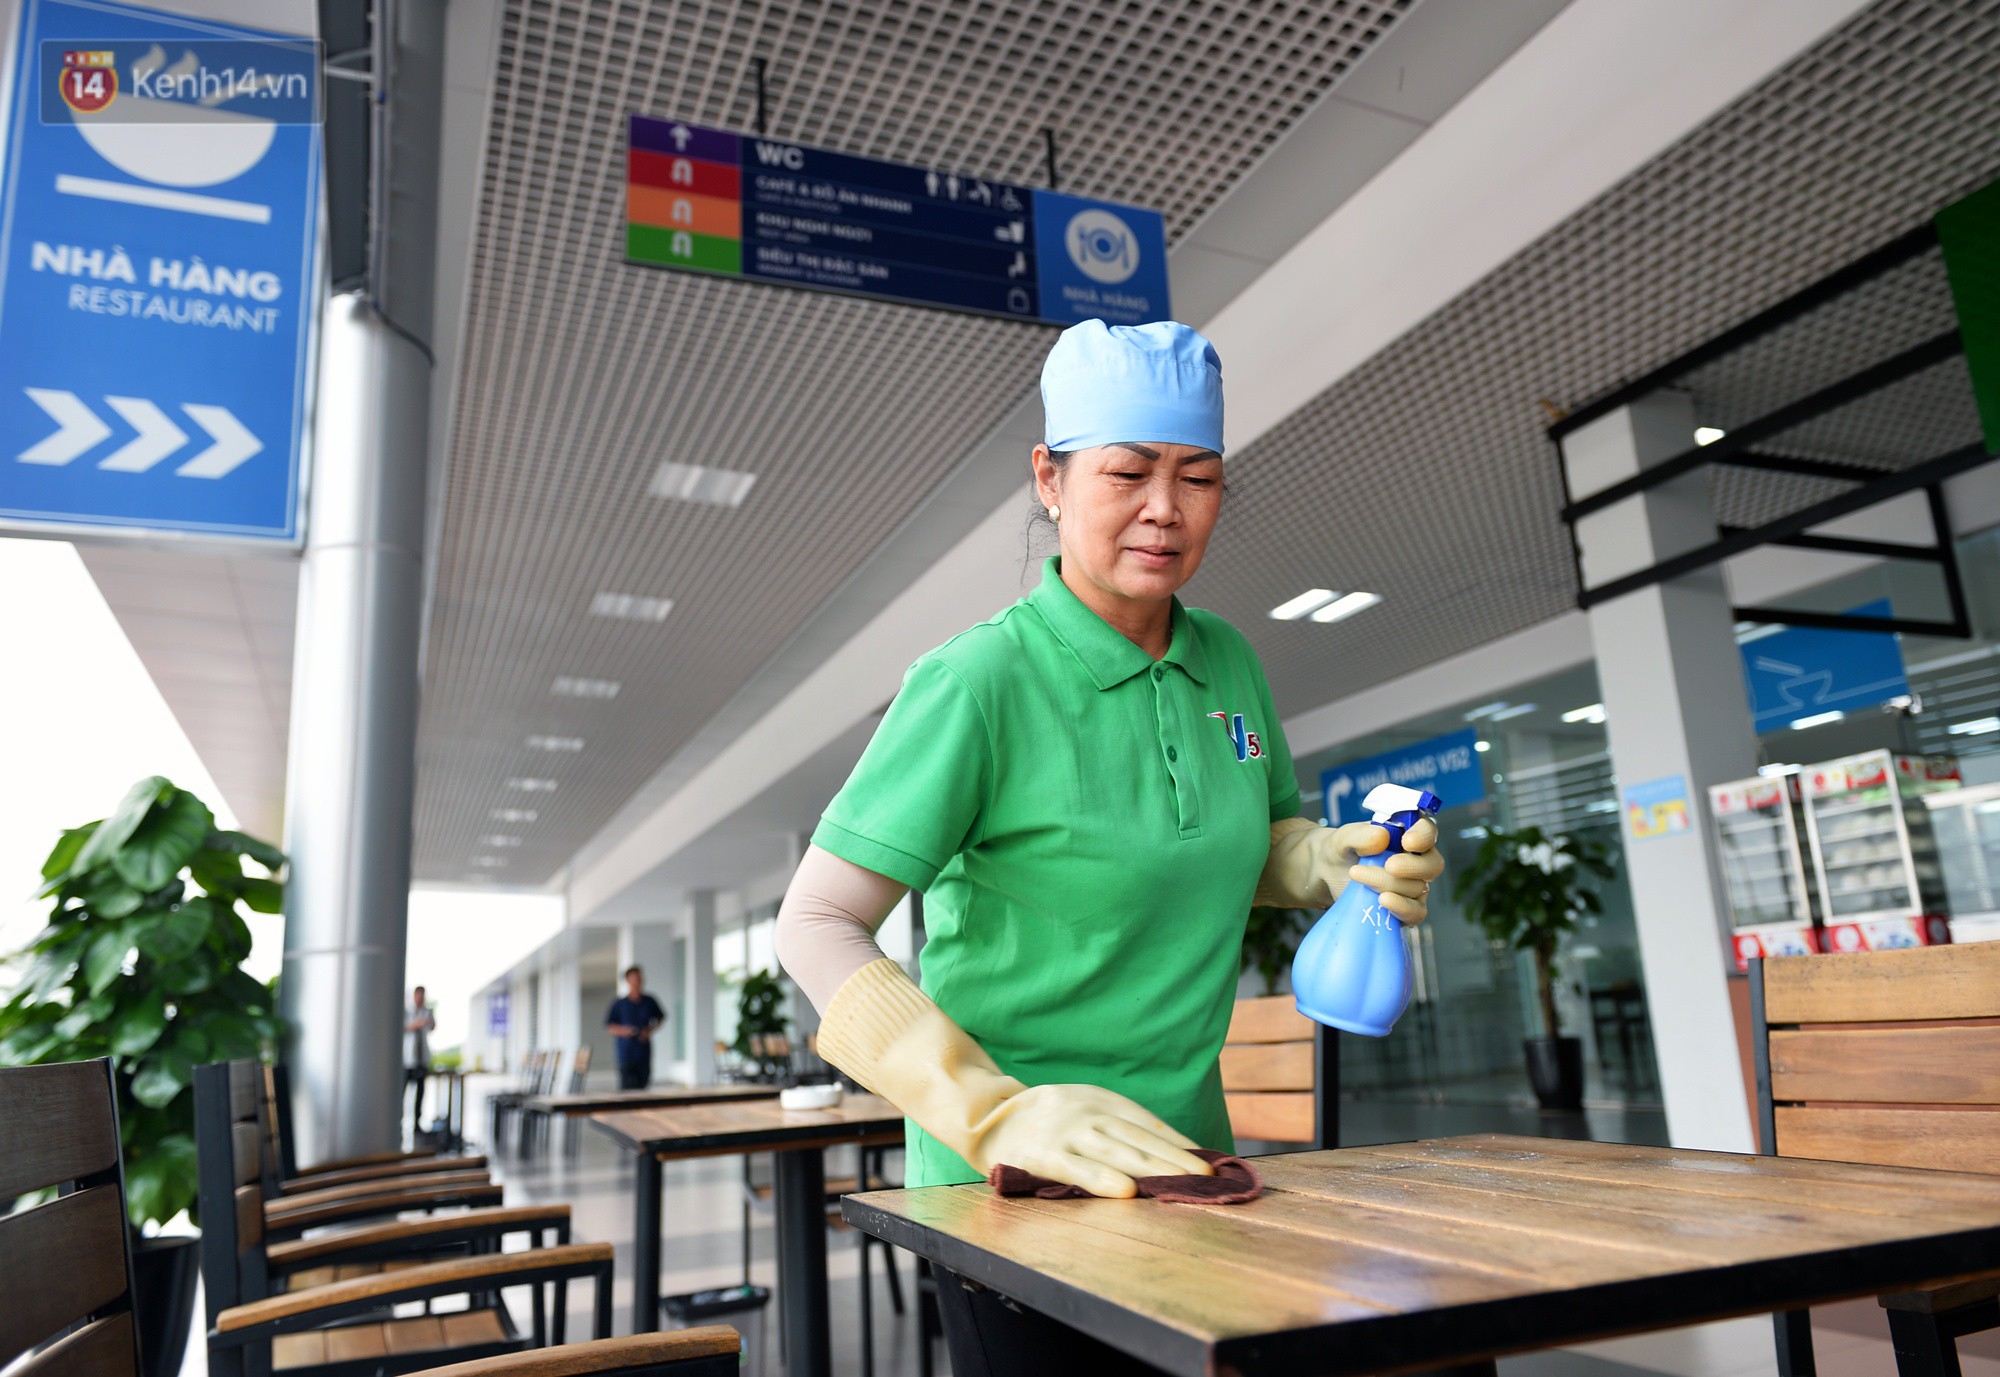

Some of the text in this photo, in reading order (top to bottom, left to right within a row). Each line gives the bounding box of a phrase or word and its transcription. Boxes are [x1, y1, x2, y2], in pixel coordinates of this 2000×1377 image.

[755, 141, 805, 170] WC
[31, 241, 281, 302] NHÀ HÀNG
[69, 284, 280, 335] RESTAURANT
[1062, 285, 1150, 313] NHÀ HÀNG
[1437, 746, 1471, 773] V52
